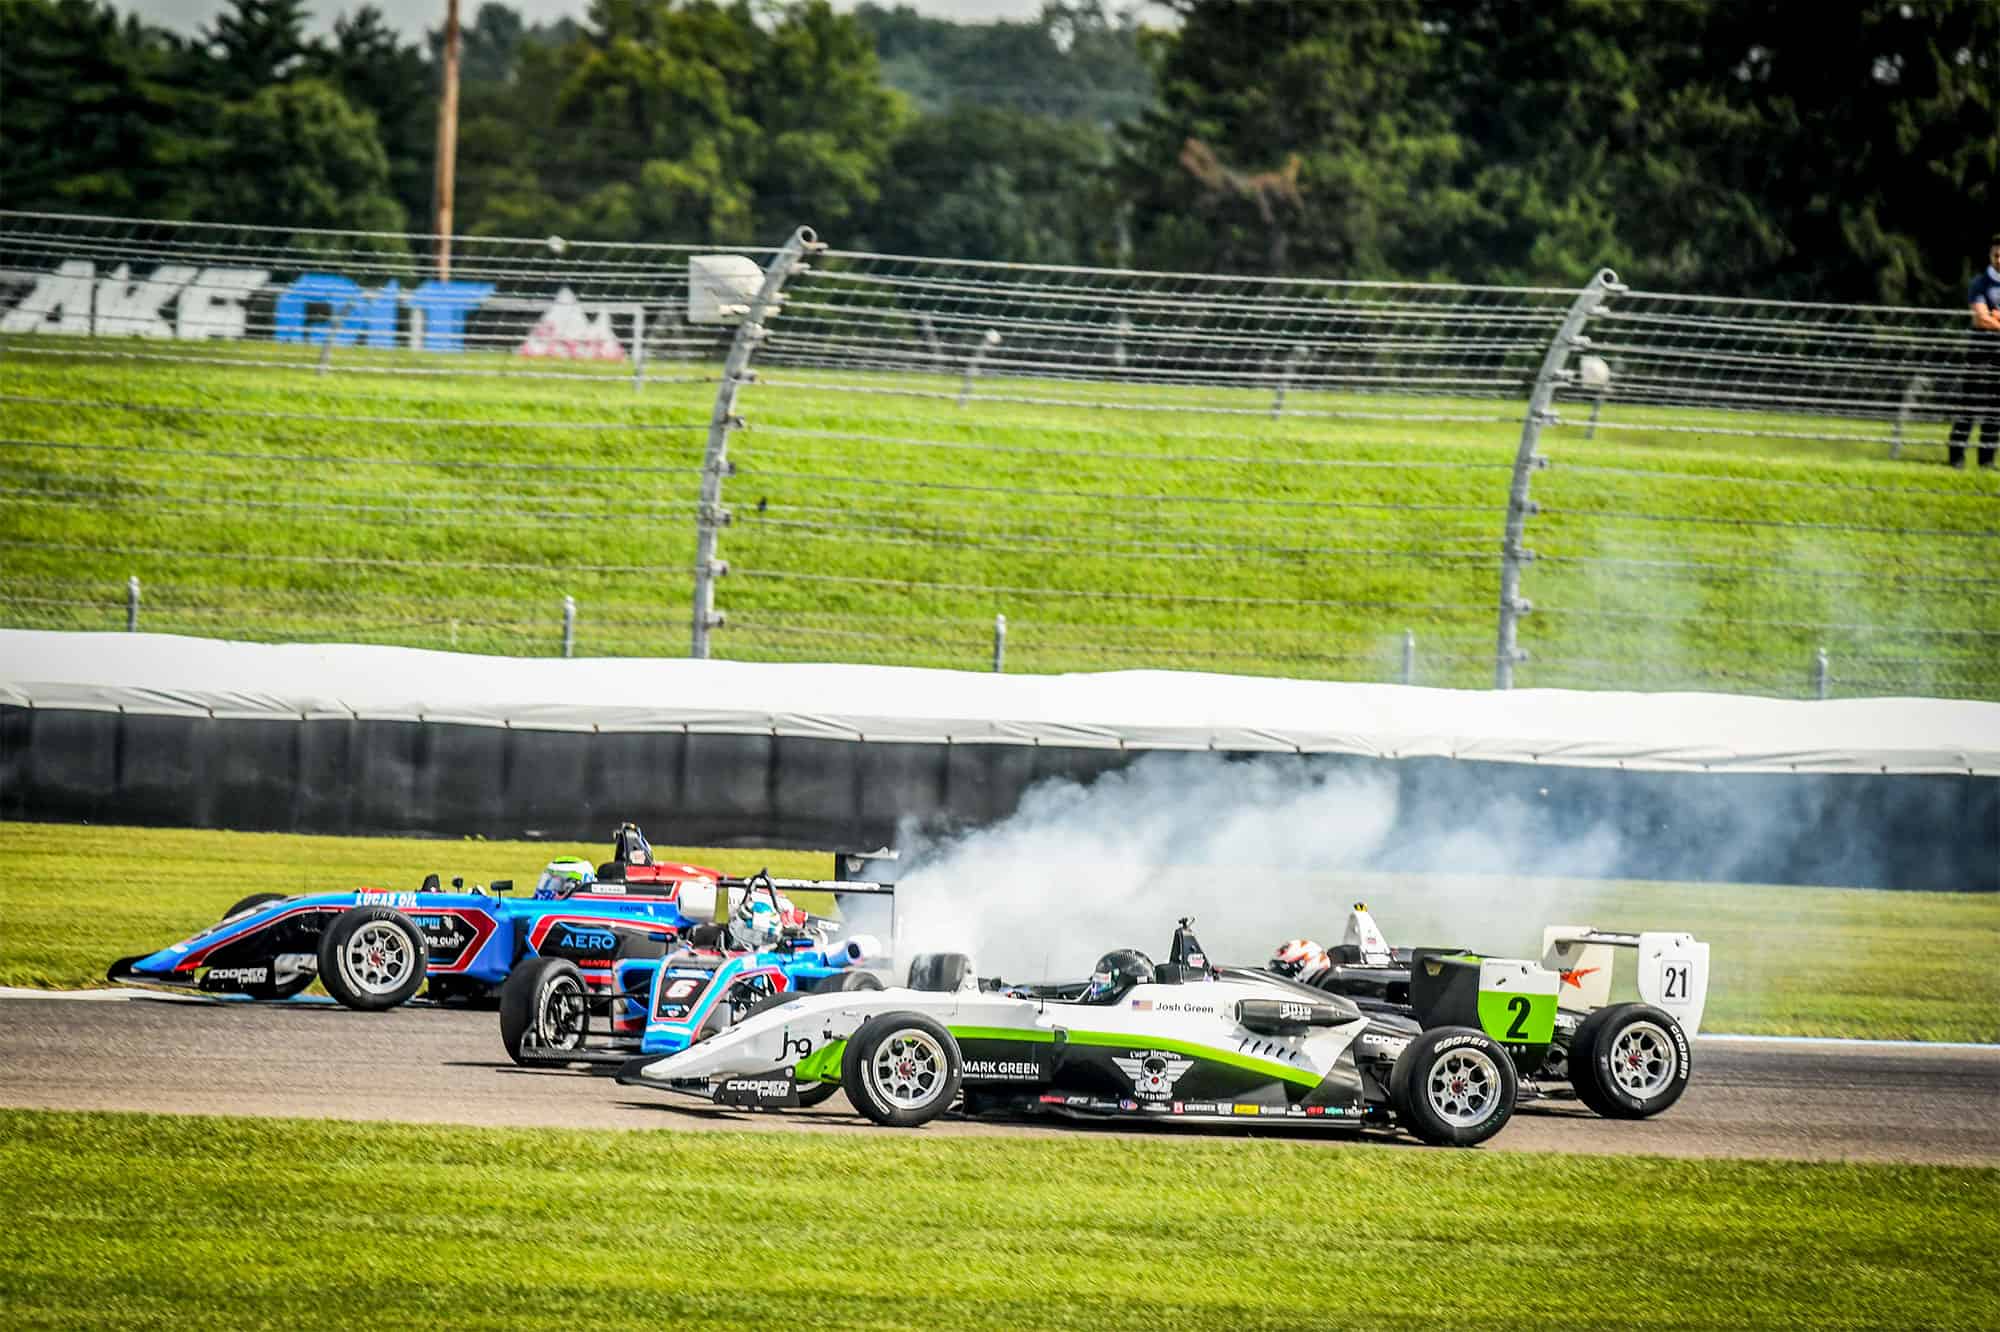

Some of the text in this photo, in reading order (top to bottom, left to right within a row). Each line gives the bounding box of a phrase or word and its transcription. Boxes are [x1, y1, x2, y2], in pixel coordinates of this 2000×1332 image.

[356, 893, 417, 907] LUCAS OIL
[561, 933, 616, 950] AERO
[209, 967, 268, 979] COOPER
[665, 979, 699, 998] 6
[1665, 967, 1688, 998] 21
[1156, 1002, 1214, 1014] Josh Green
[1506, 997, 1531, 1040] 2
[774, 1024, 812, 1062] jhg
[1434, 1036, 1489, 1053] COOPER
[1671, 1025, 1689, 1080] COOPER
[962, 1061, 1039, 1074] MARK GREEN
[726, 1080, 789, 1091] COOPER
